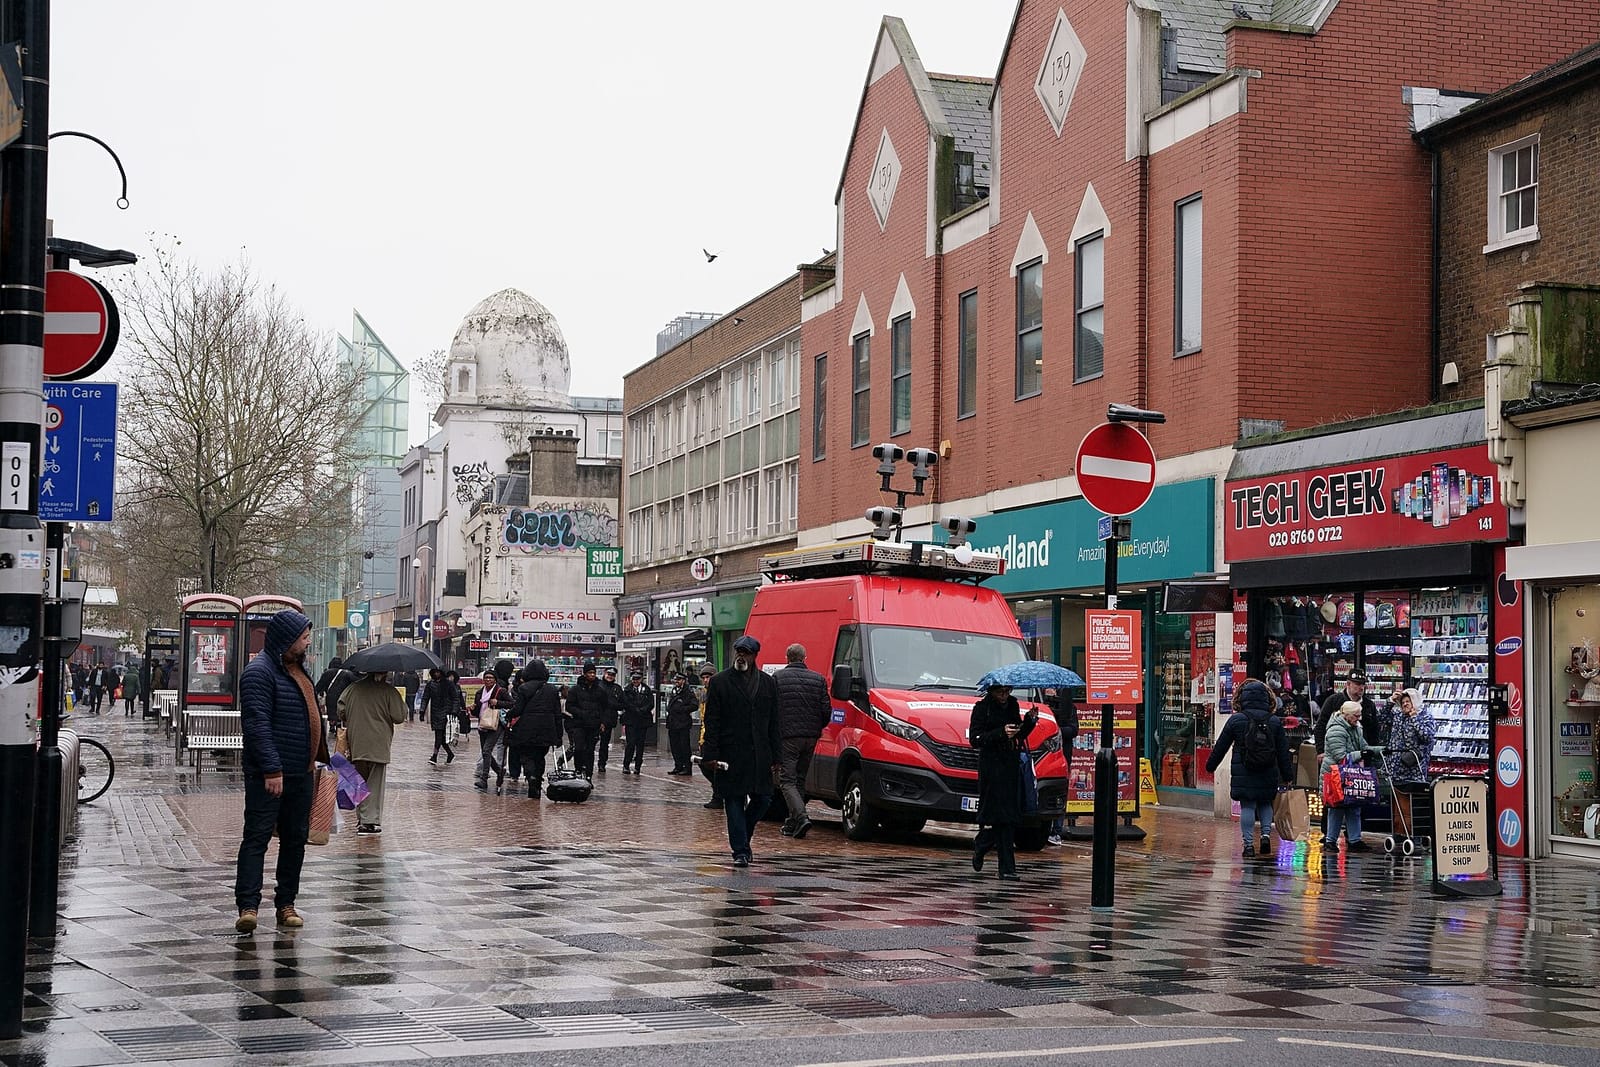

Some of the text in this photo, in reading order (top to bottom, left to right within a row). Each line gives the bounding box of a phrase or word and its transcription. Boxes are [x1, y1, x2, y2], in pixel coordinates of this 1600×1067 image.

[1050, 51, 1071, 86] 139
[1058, 90, 1064, 107] B
[878, 163, 892, 191] 139
[72, 387, 102, 398] Care
[1232, 467, 1386, 529] TECH GEEK
[61, 501, 74, 509] Keep
[1478, 517, 1492, 530] 141
[1269, 526, 1342, 547] 020 8760 0722
[592, 551, 620, 562] SHOP
[590, 563, 621, 575] TO LET
[522, 610, 564, 620] FONES
[577, 612, 601, 621] ALL
[1092, 618, 1112, 626] POLICE
[543, 633, 562, 643] VAPES
[1498, 642, 1519, 650] SAMSUNG
[1496, 717, 1522, 726] HUAWEI
[1500, 762, 1518, 771] DELL
[1450, 786, 1470, 798] JUZ
[1441, 801, 1479, 814] LOOKIN
[1449, 820, 1473, 829] LADIES
[1502, 810, 1517, 846] hp
[1446, 833, 1476, 841] FASHION
[1442, 844, 1481, 854] & PERFUME
[1453, 857, 1472, 866] SHOP
